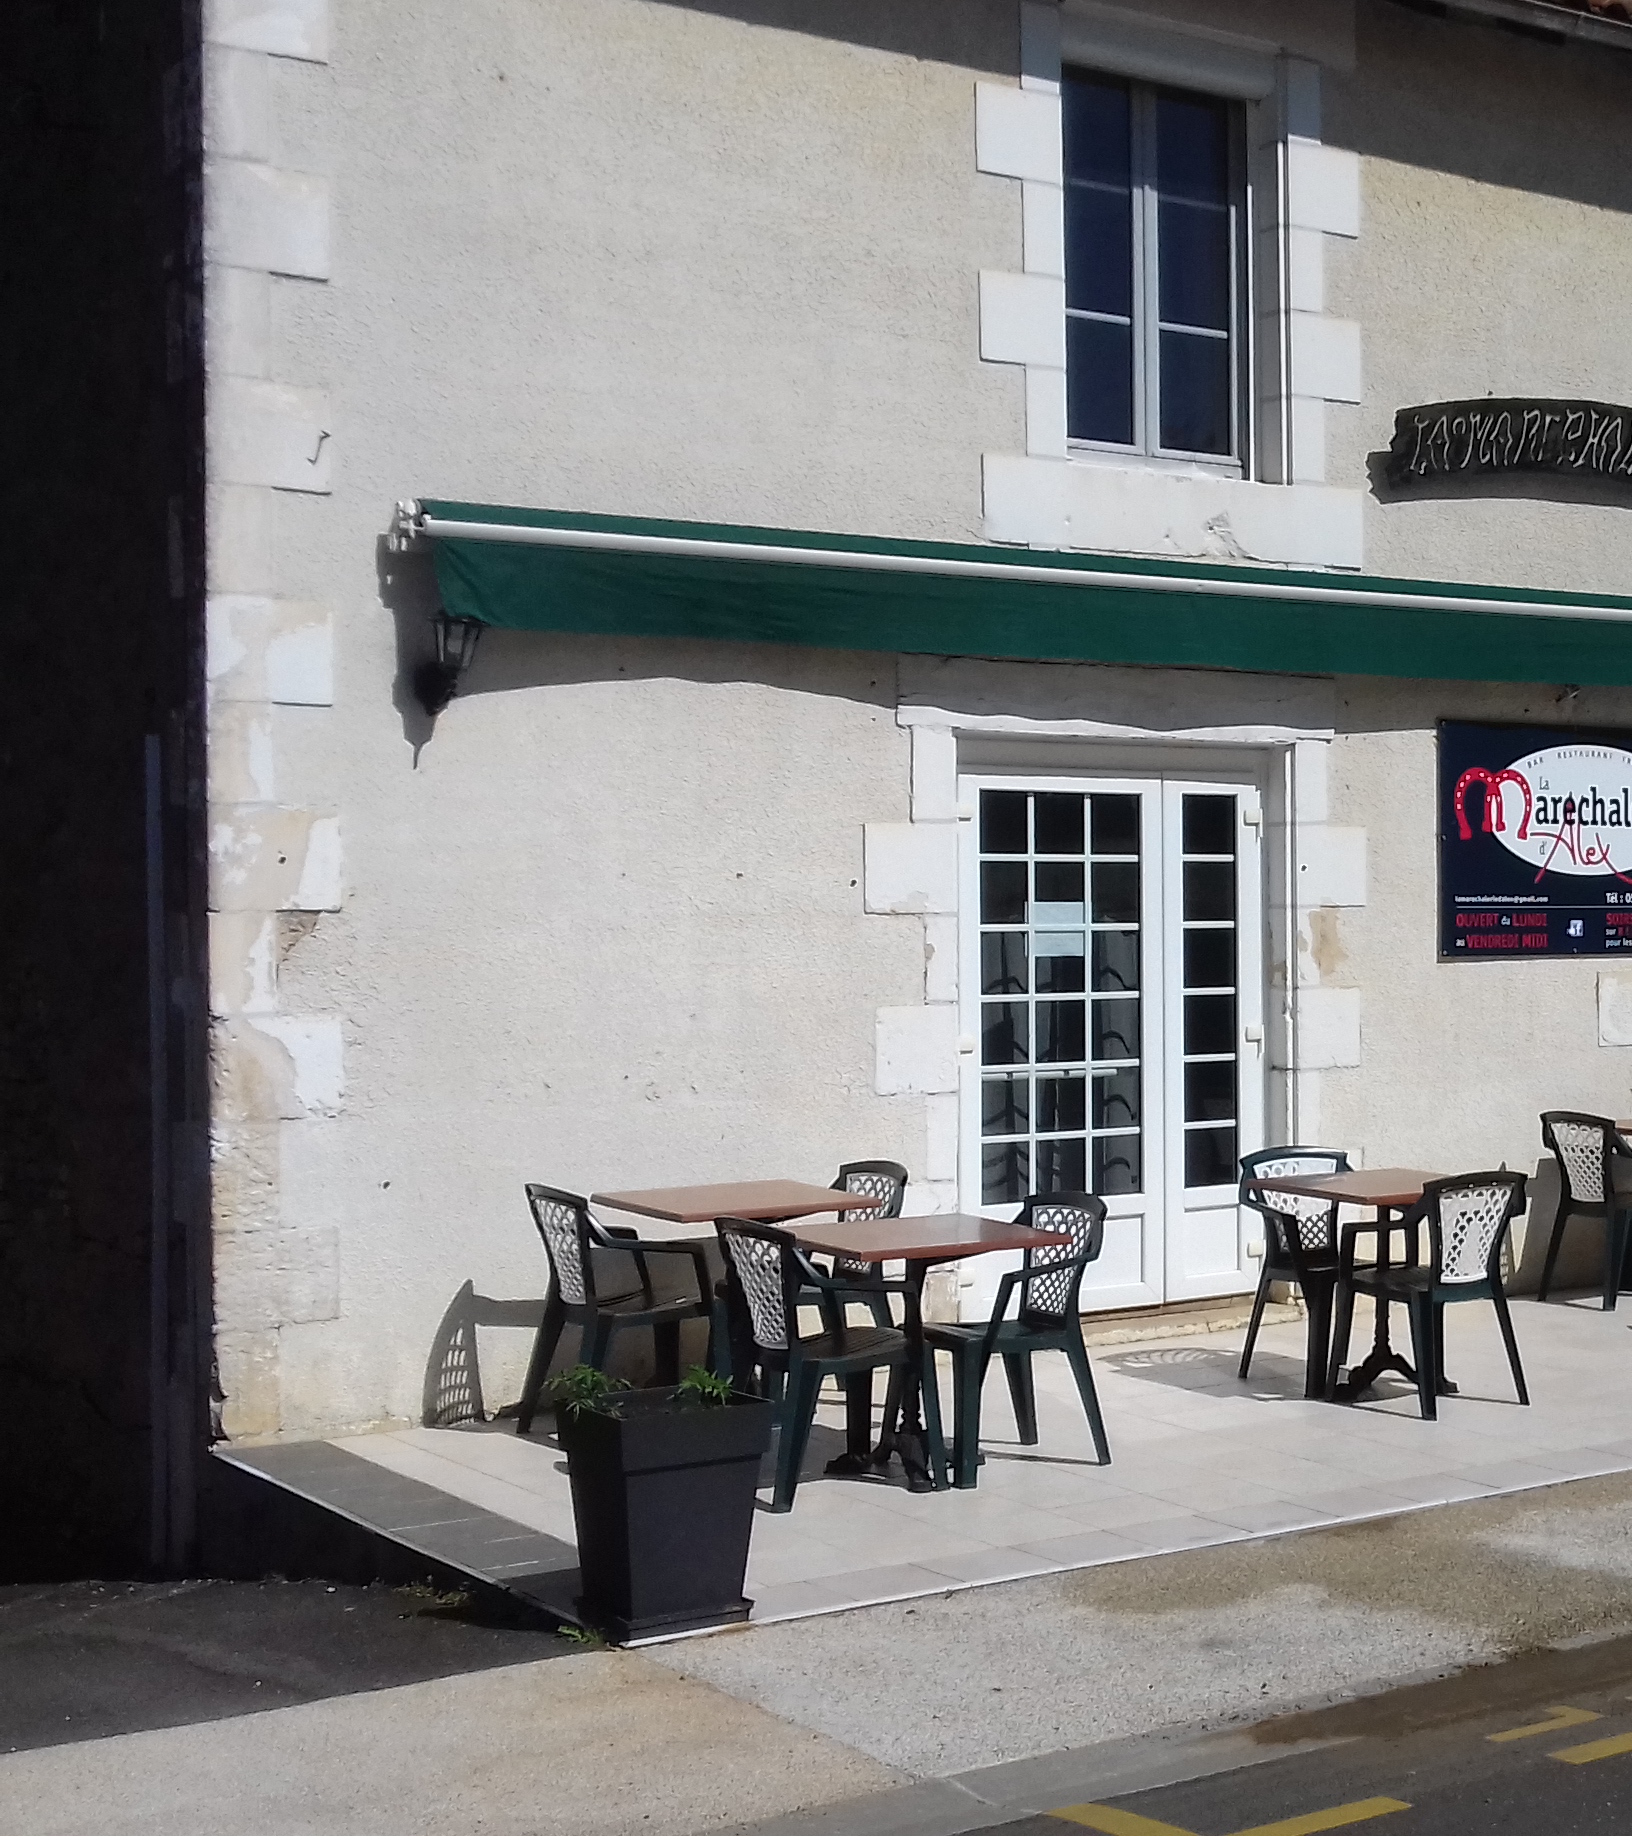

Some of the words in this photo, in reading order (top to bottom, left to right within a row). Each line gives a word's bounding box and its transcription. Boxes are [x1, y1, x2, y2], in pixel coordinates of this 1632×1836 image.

[1527, 757, 1544, 769] BAR
[1557, 749, 1613, 760] RESTAURANT
[1539, 776, 1550, 791] La
[1456, 913, 1499, 927] OUVERT
[1501, 916, 1511, 926] du
[1512, 913, 1547, 927] LUNDI
[1466, 934, 1519, 949] VENDREDI
[1522, 933, 1549, 948] MIDI
[1605, 939, 1621, 949] pour
[1622, 937, 1632, 947] les
